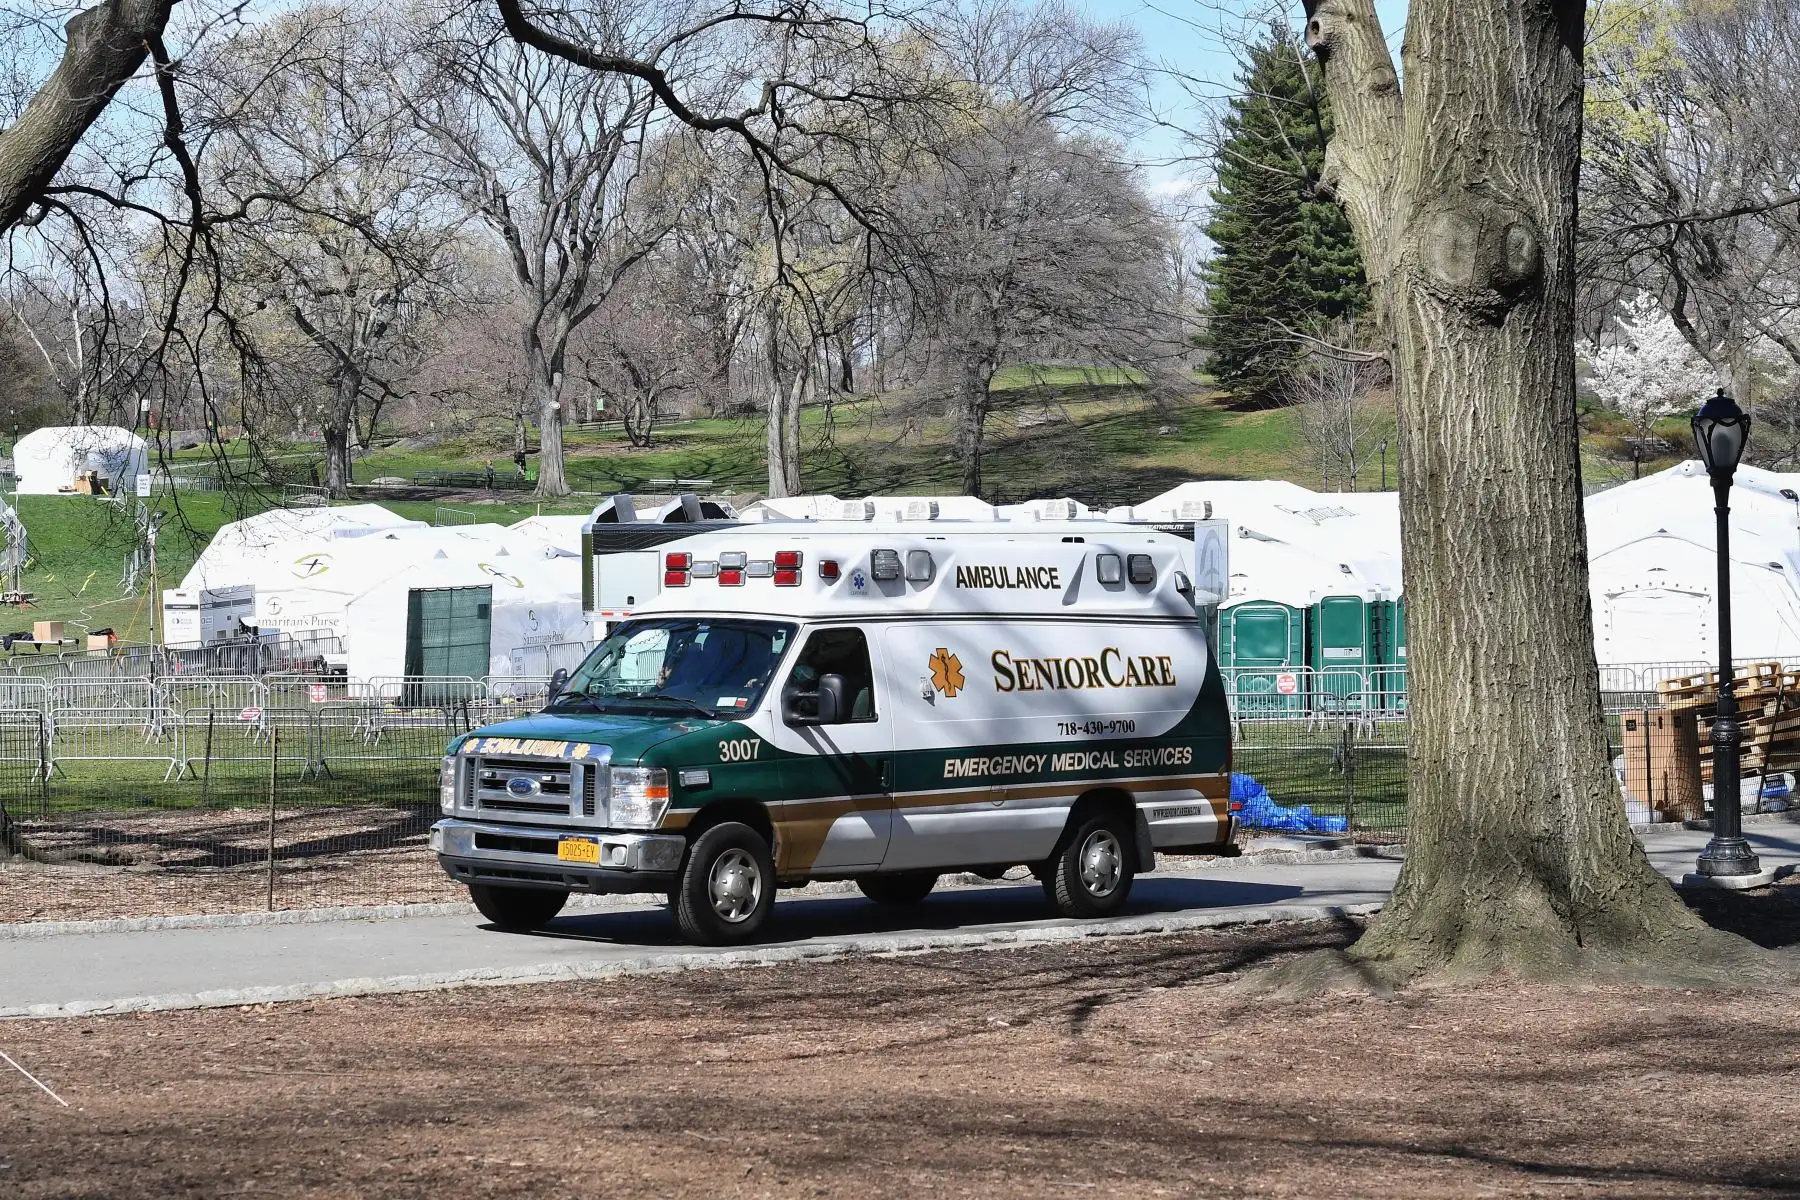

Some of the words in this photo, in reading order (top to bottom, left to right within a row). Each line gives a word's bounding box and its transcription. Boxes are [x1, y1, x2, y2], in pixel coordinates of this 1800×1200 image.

[956, 565, 1062, 589] AMBULANCE
[256, 615, 309, 627] amaritan's
[311, 615, 340, 627] Purse
[1057, 719, 1136, 736] 718-430-9700
[718, 739, 761, 762] 3007
[943, 754, 1048, 778] EMERGENCY
[1050, 750, 1120, 772] MEDICAL
[1123, 746, 1193, 768] SERVICES
